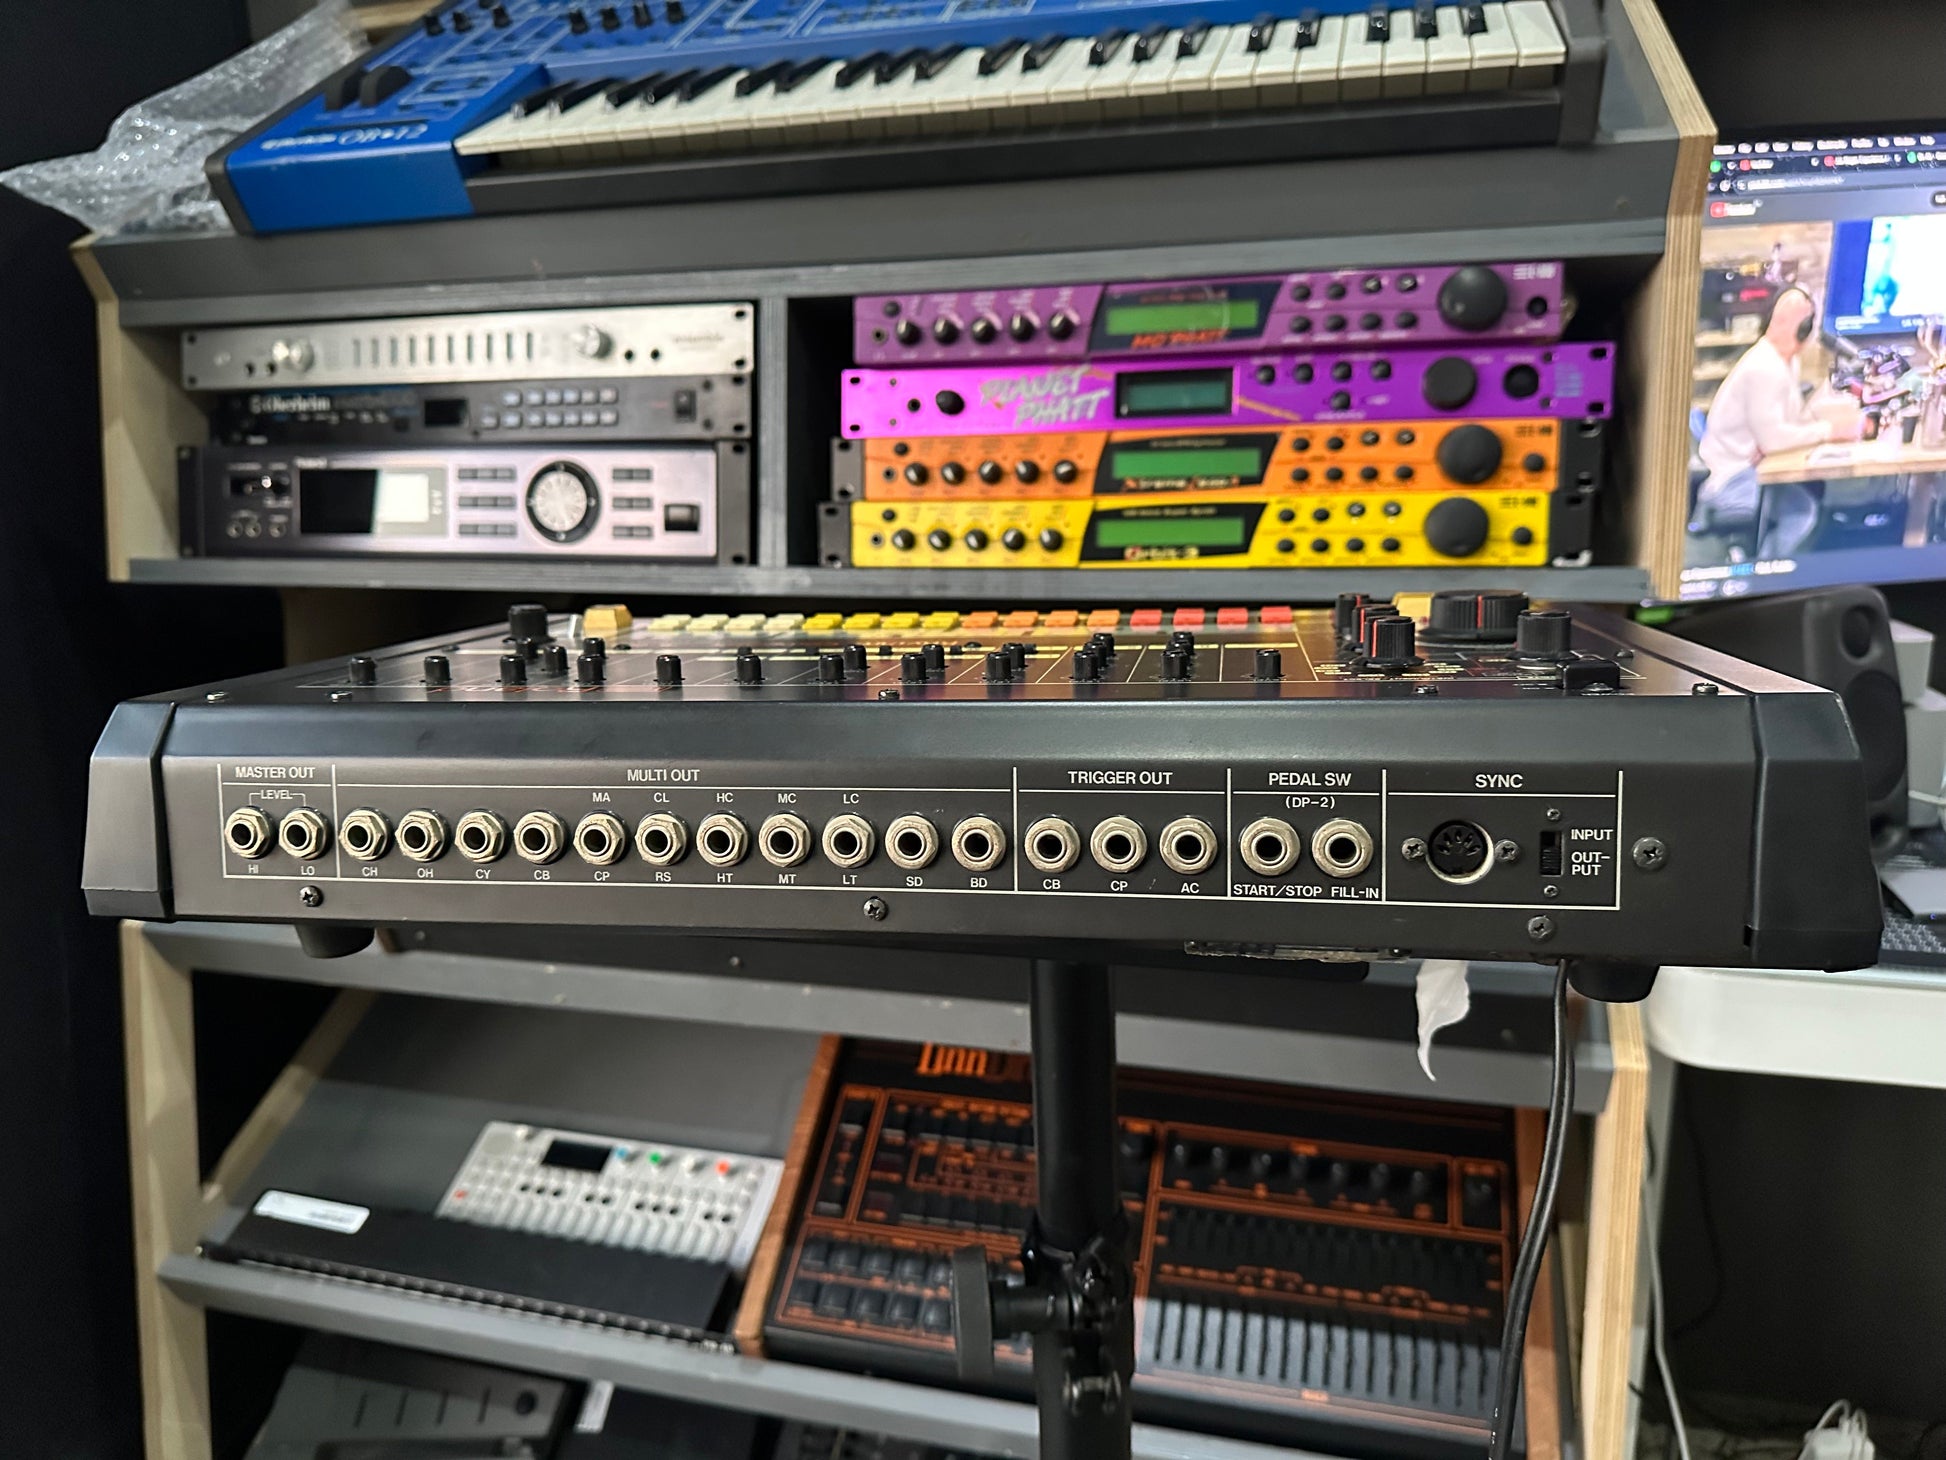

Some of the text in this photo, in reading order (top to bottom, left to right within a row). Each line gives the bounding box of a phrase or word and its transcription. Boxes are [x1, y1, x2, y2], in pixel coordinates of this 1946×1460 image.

[235, 766, 316, 779] MASTER OUT
[627, 768, 701, 782] MULTI OUT
[1067, 770, 1174, 785] TRIGGER OUT
[1268, 772, 1352, 787] PEDAL SW
[1475, 773, 1524, 789] SYNC
[260, 789, 293, 800] LEVEL
[592, 792, 611, 803] MA
[653, 792, 670, 803] CL
[716, 792, 734, 803] HC
[777, 793, 797, 804] MC
[843, 793, 860, 804] LC
[1285, 796, 1336, 810] (DP-2)
[1571, 828, 1614, 841] INPUT
[1571, 851, 1611, 864] OUT-
[247, 864, 259, 875] HI
[300, 865, 315, 876] LO
[361, 866, 378, 878] CH
[416, 867, 434, 879] OH
[475, 868, 492, 880] CY
[533, 869, 551, 881] CB
[1571, 864, 1602, 876] PUT
[594, 870, 611, 882] CP
[654, 871, 672, 883] RS
[716, 872, 734, 884] HT
[777, 873, 797, 885] MT
[842, 874, 858, 885] LT
[905, 875, 924, 887] SD
[970, 877, 988, 889] BD
[1042, 878, 1062, 890] CB
[1109, 880, 1129, 892] CP
[1180, 882, 1201, 894] AC
[1233, 883, 1380, 899] START/STOP FILL-IN
